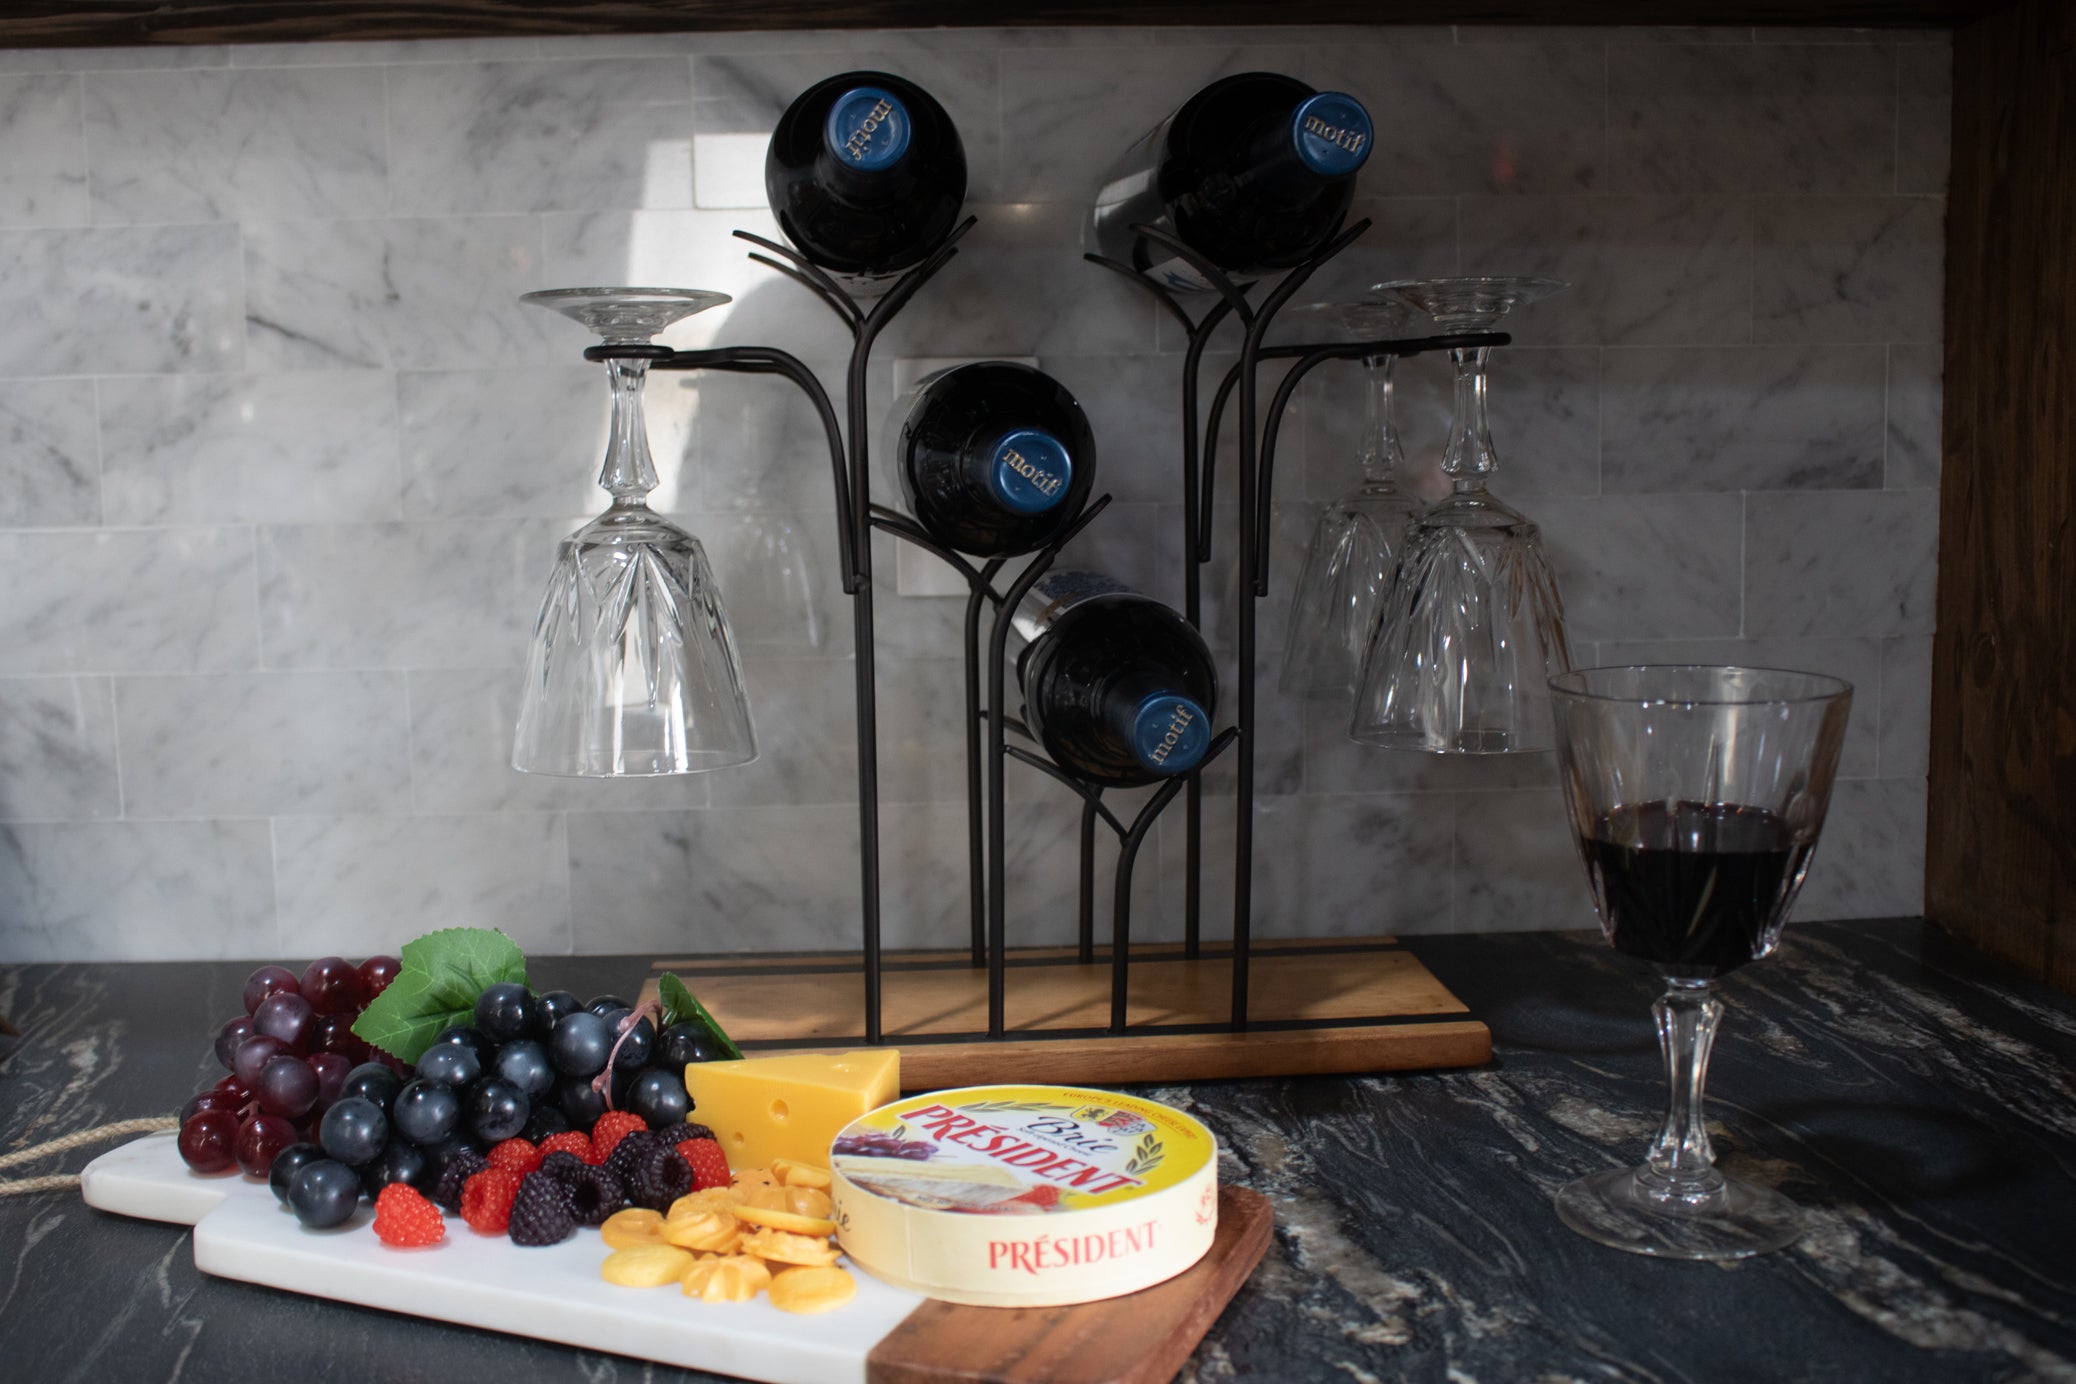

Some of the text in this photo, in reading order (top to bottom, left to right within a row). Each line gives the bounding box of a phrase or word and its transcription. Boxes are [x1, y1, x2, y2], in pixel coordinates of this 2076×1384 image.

[845, 98, 893, 161] motif
[1305, 115, 1366, 154] motif
[1002, 448, 1062, 497] motif
[1151, 704, 1193, 766] motif
[901, 1104, 1142, 1194] PRÉSIDENT
[1026, 1115, 1119, 1154] Brie
[987, 1219, 1160, 1275] PRÉSIDENT
